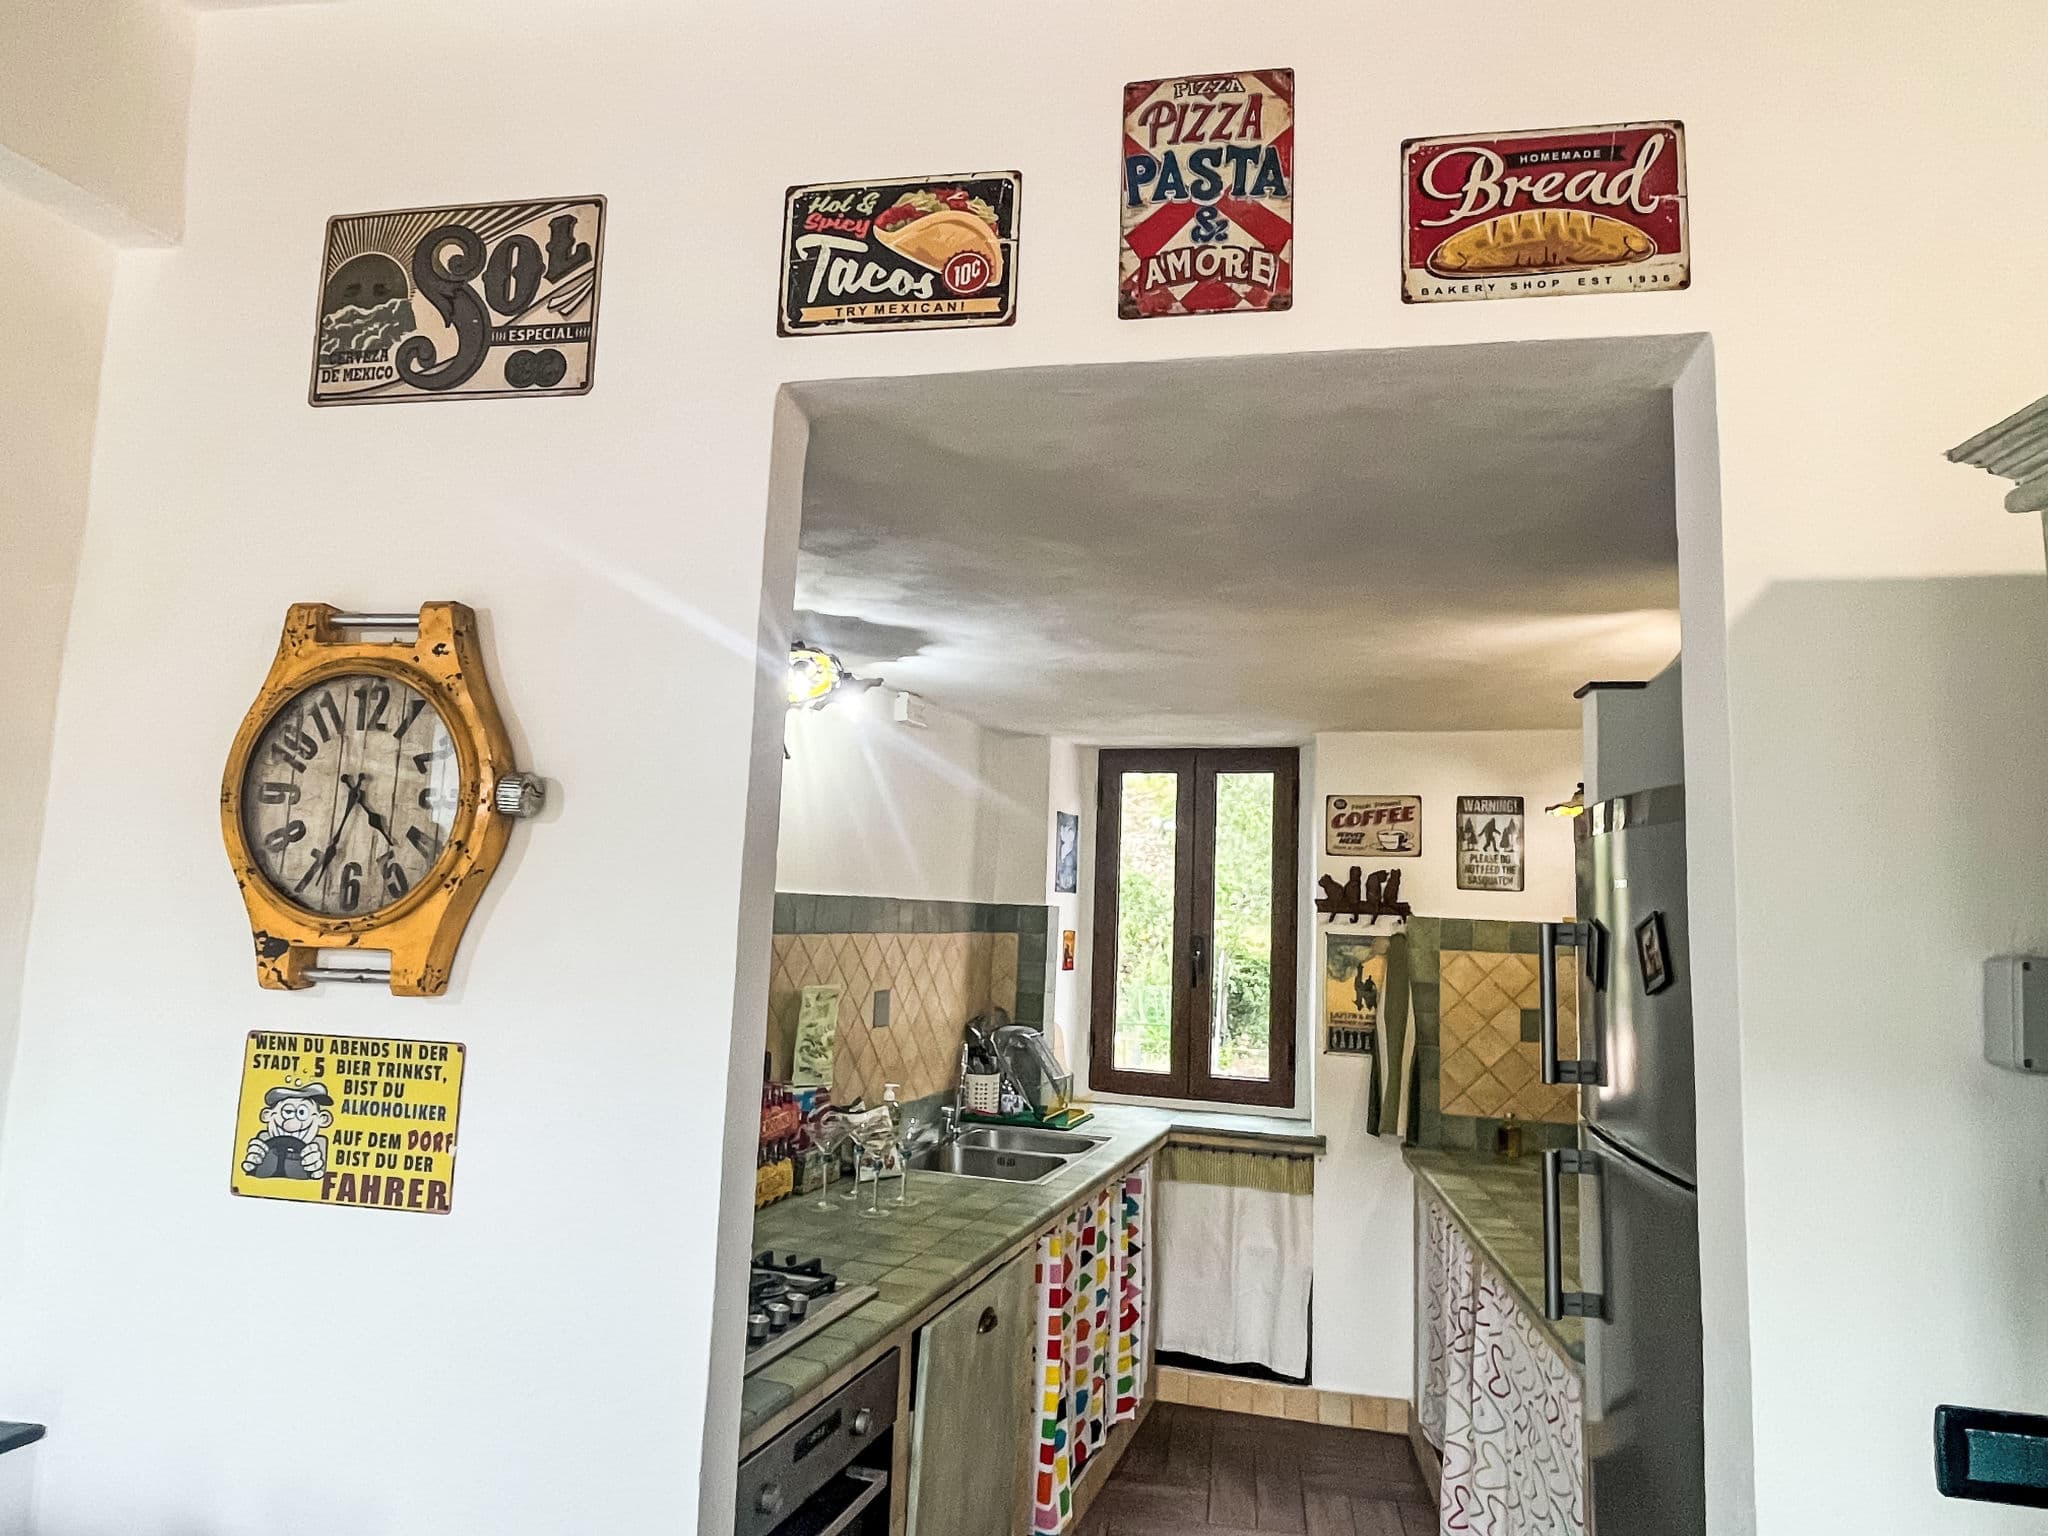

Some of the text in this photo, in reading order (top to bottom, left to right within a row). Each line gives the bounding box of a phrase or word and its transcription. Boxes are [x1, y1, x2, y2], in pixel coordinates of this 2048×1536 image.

[1174, 77, 1245, 99] PIZZA
[1138, 93, 1263, 147] PIZZA
[1519, 149, 1602, 165] HOMEMADE
[1125, 144, 1288, 207] PASTA
[1421, 132, 1665, 227] Bread
[808, 191, 880, 216] Hot &
[803, 212, 872, 239] Spicy
[1191, 205, 1228, 243] &
[796, 233, 935, 304] Tacos
[1144, 247, 1275, 291] AMORE
[1421, 282, 1497, 296] BAKERY
[1510, 278, 1561, 291] SHOP
[1577, 276, 1613, 286] EST
[835, 301, 966, 317] TRY MEXICAN!
[508, 327, 574, 342] ESPECIAL
[321, 365, 394, 383] DE MEXICO
[308, 691, 344, 743] 11
[354, 685, 390, 731] 12
[1331, 806, 1416, 829] COFFEE
[1463, 799, 1518, 813] WARNING!
[1470, 853, 1499, 864] PLEASE
[1502, 865, 1516, 875] THE
[339, 861, 362, 911] 6
[256, 1034, 448, 1062] WENN DU ABENDS IN DER
[314, 1056, 325, 1078] 5
[336, 1059, 371, 1077] BIER
[377, 1061, 447, 1084] TRINKST,
[344, 1079, 405, 1098] BIST DU
[341, 1099, 446, 1122] ALKOHOLIKER
[332, 1129, 453, 1154] AUF DEM DORF
[336, 1150, 434, 1172] BIST DU DER
[321, 1171, 449, 1211] FAHRER
